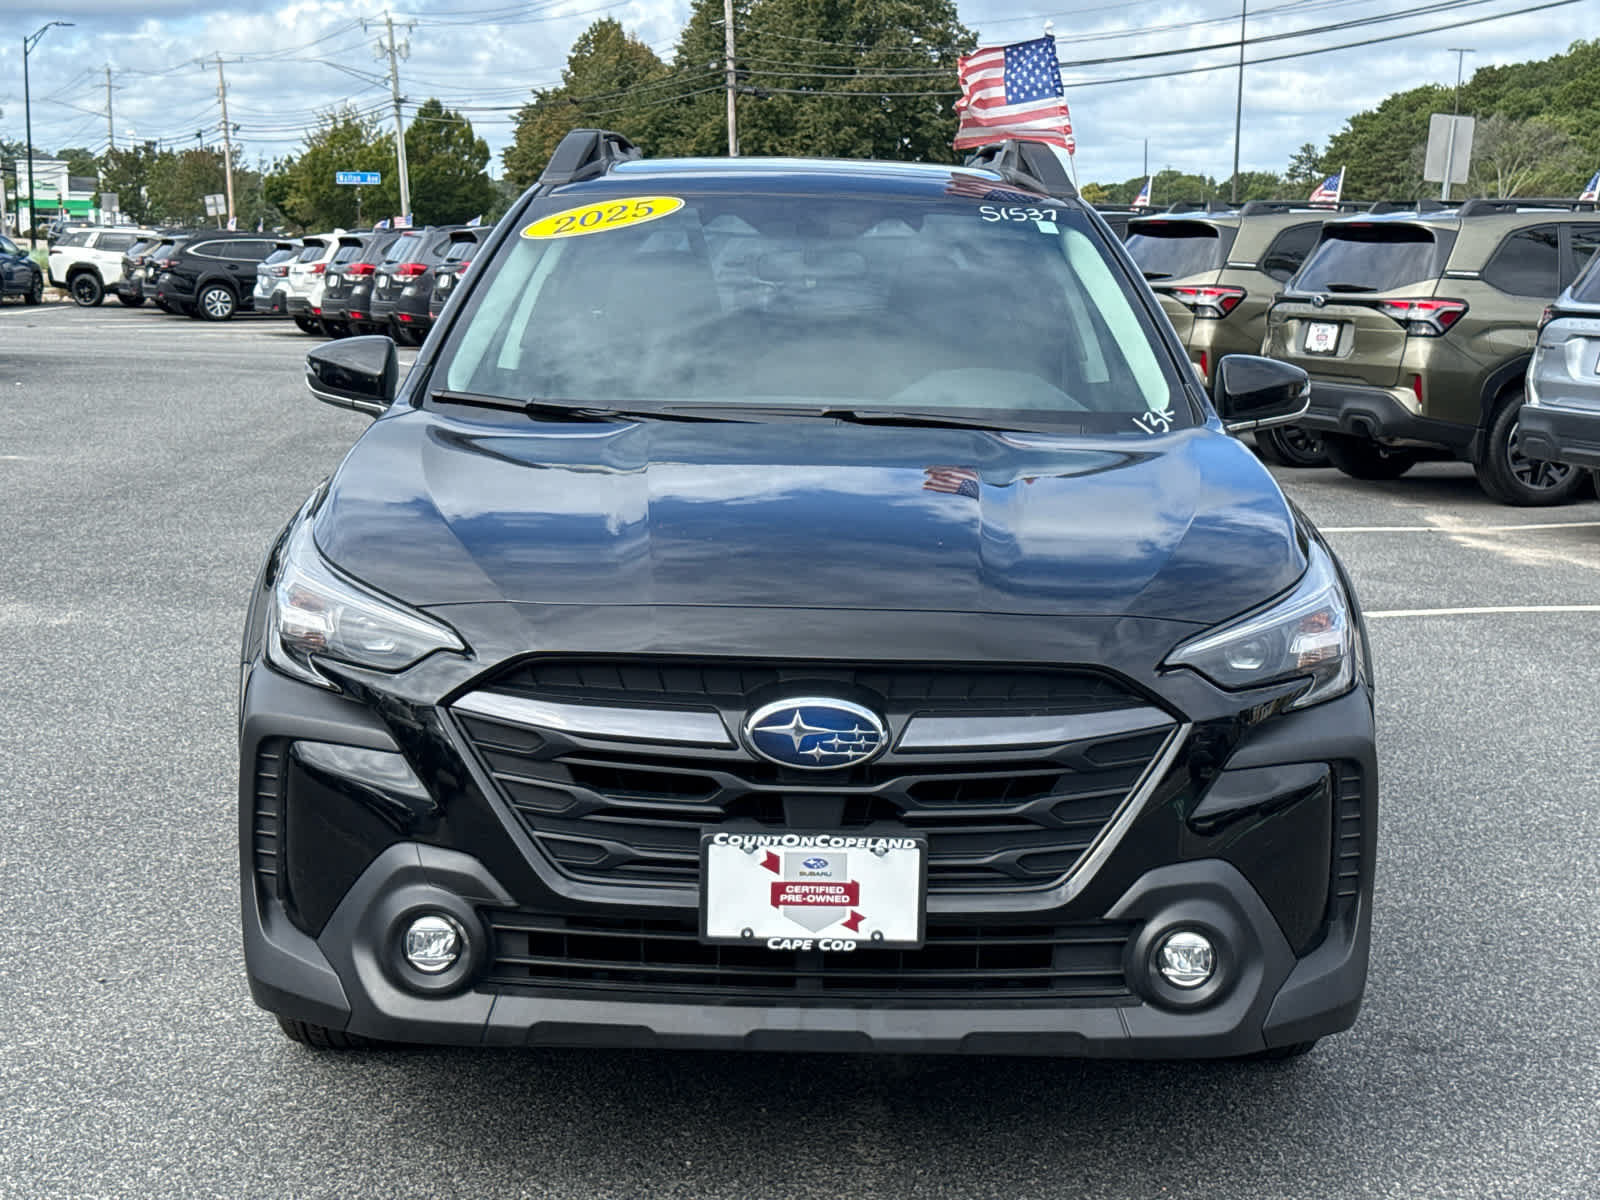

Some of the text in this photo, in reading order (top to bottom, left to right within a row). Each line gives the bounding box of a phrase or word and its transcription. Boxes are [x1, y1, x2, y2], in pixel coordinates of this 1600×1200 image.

[553, 200, 656, 235] 2025
[713, 832, 916, 849] COUNTONCOPELAND
[785, 885, 845, 894] CERTIFIED
[780, 894, 850, 903] PRE-OWNED
[767, 937, 857, 951] CAPE COD
